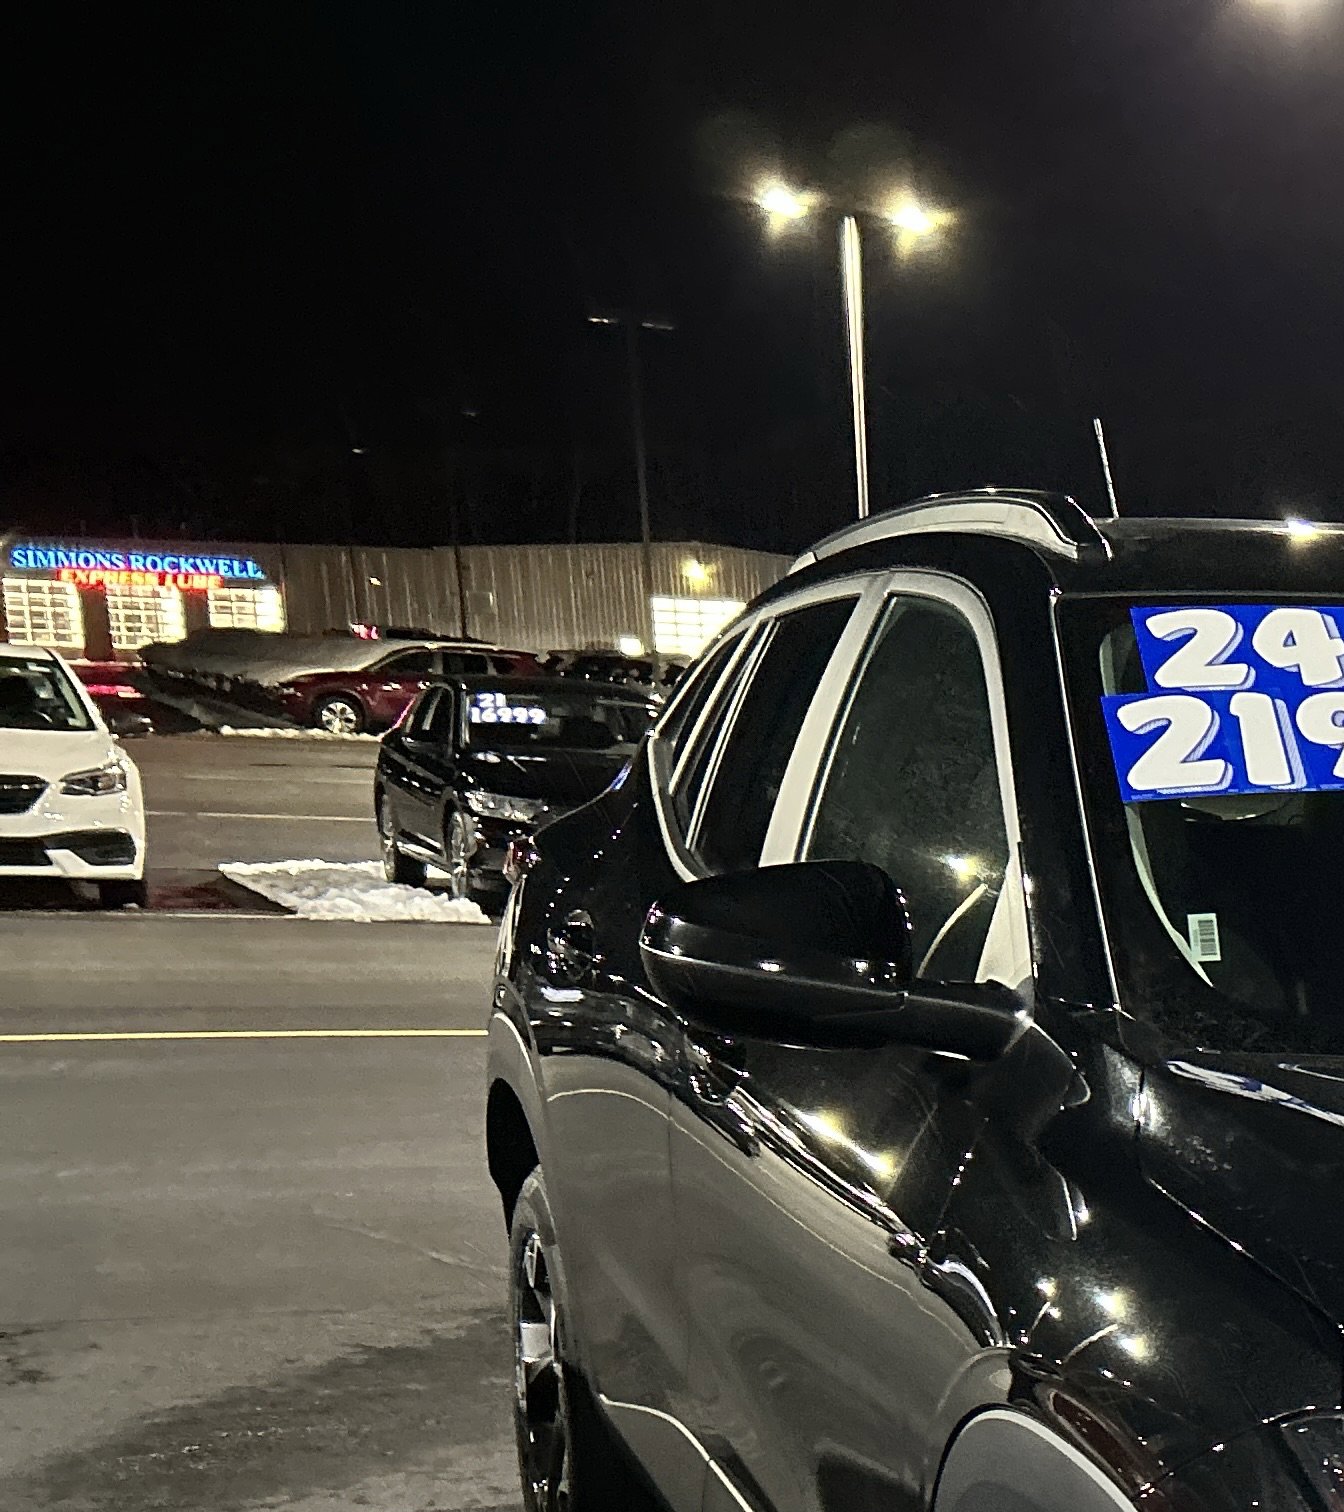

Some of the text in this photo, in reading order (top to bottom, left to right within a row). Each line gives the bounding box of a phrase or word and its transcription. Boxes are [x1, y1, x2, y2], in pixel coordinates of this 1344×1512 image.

[11, 548, 265, 579] SIMMONS ROCKWELL
[470, 706, 547, 724] 16999
